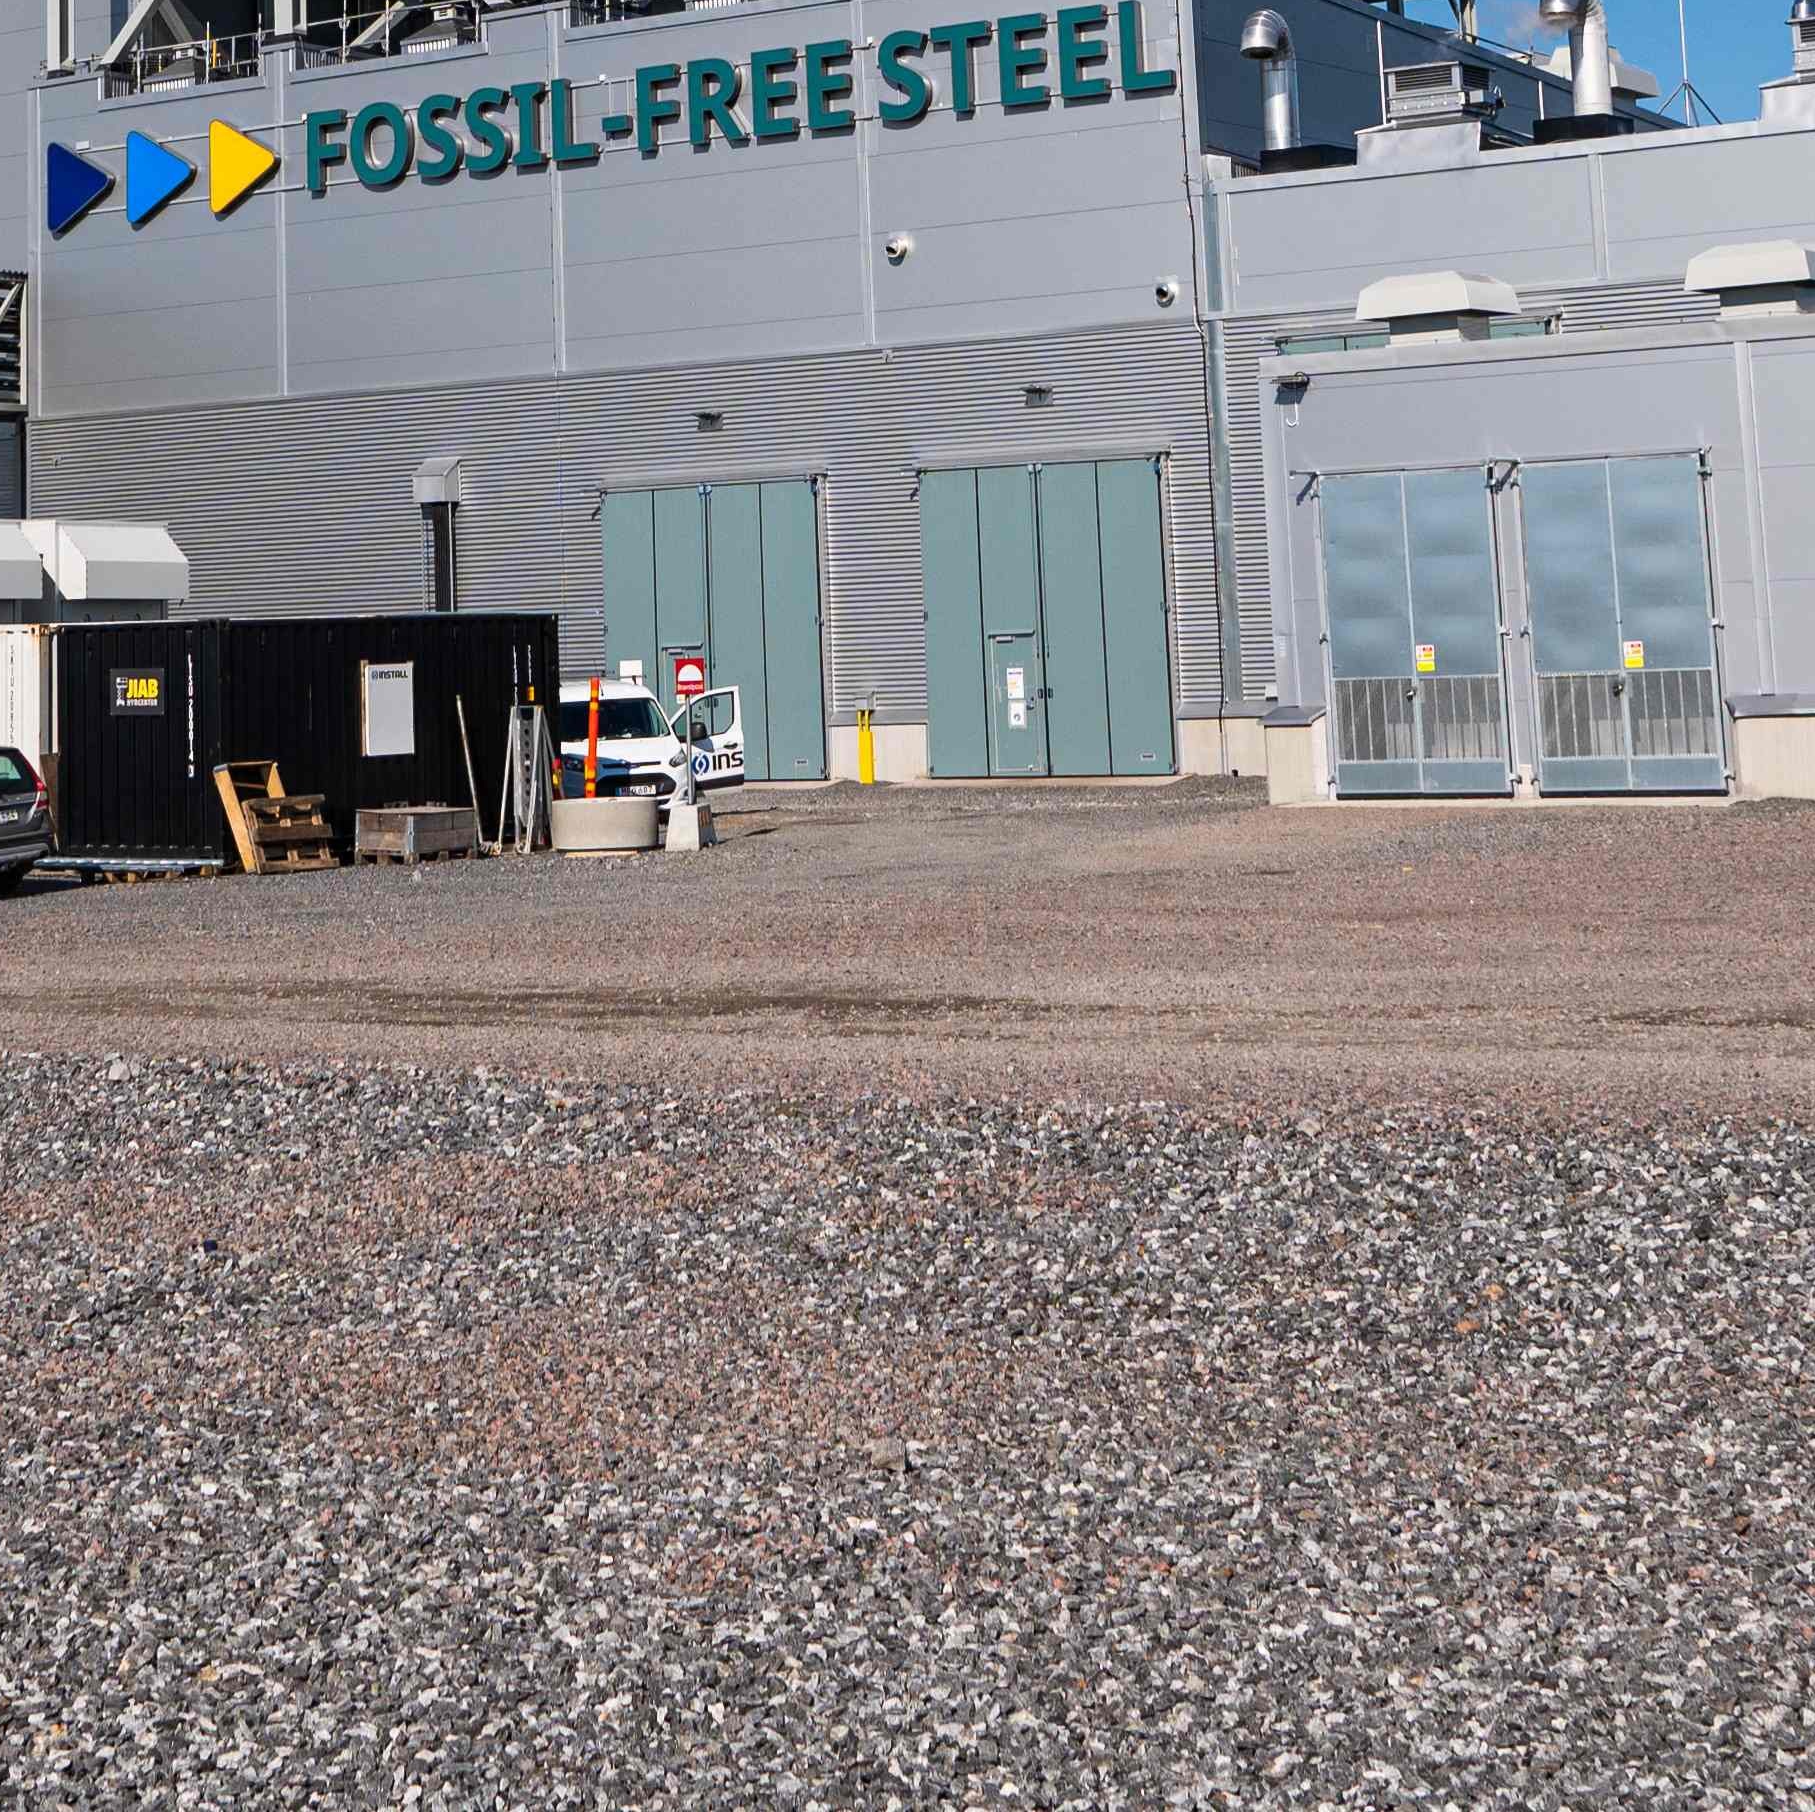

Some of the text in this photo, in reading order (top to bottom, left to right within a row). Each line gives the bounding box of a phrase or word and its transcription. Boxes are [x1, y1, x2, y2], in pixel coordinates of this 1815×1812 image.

[305, 0, 1176, 194] FOSSIL-FREE STEEL
[127, 678, 159, 699] JIAB
